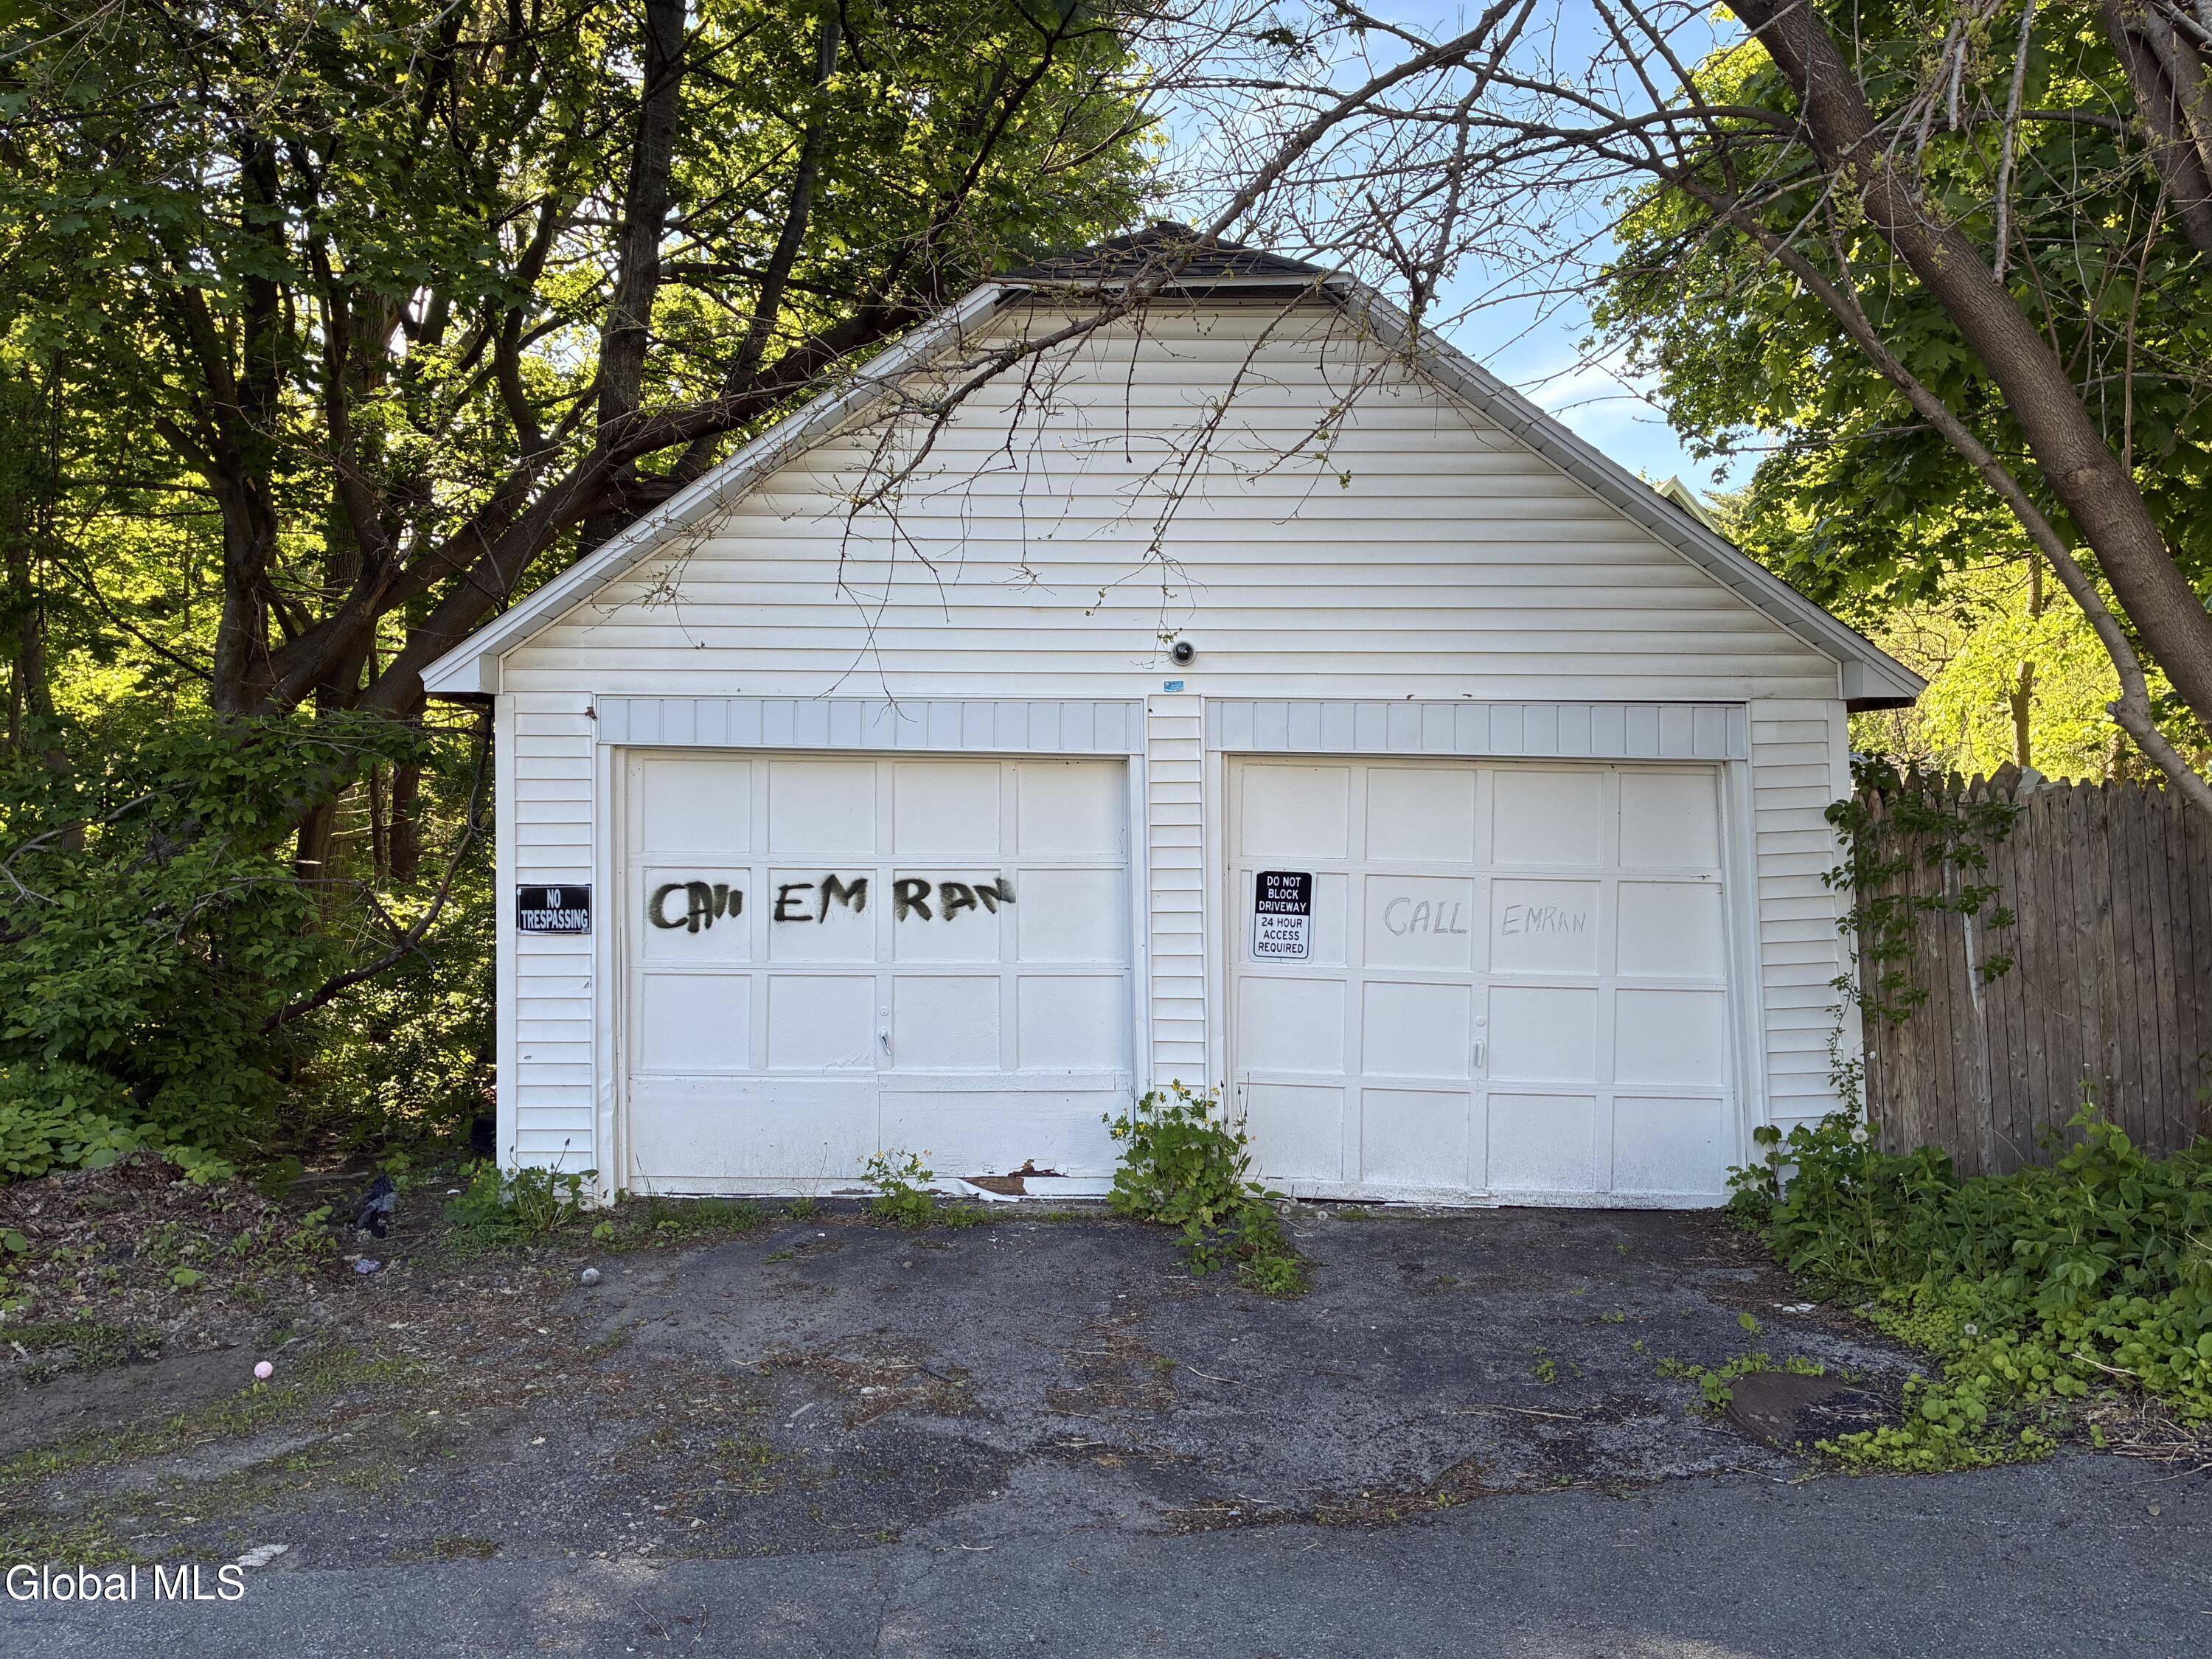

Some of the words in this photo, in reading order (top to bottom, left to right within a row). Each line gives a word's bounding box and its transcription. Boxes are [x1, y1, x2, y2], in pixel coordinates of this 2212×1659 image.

[1267, 876, 1280, 886] DO
[1282, 876, 1301, 888] NOT
[546, 888, 561, 908] NO
[1267, 888, 1298, 900] BLOCK
[1259, 900, 1307, 913] DRIVEWAY
[521, 908, 588, 929] TRESPASSING
[1261, 917, 1273, 927] 24
[1277, 917, 1303, 928] HOUR
[1384, 897, 1469, 936] CALL
[1501, 903, 1587, 936] EMRAN
[1263, 930, 1300, 941] ACCESS
[1258, 942, 1304, 953] REQUIRED
